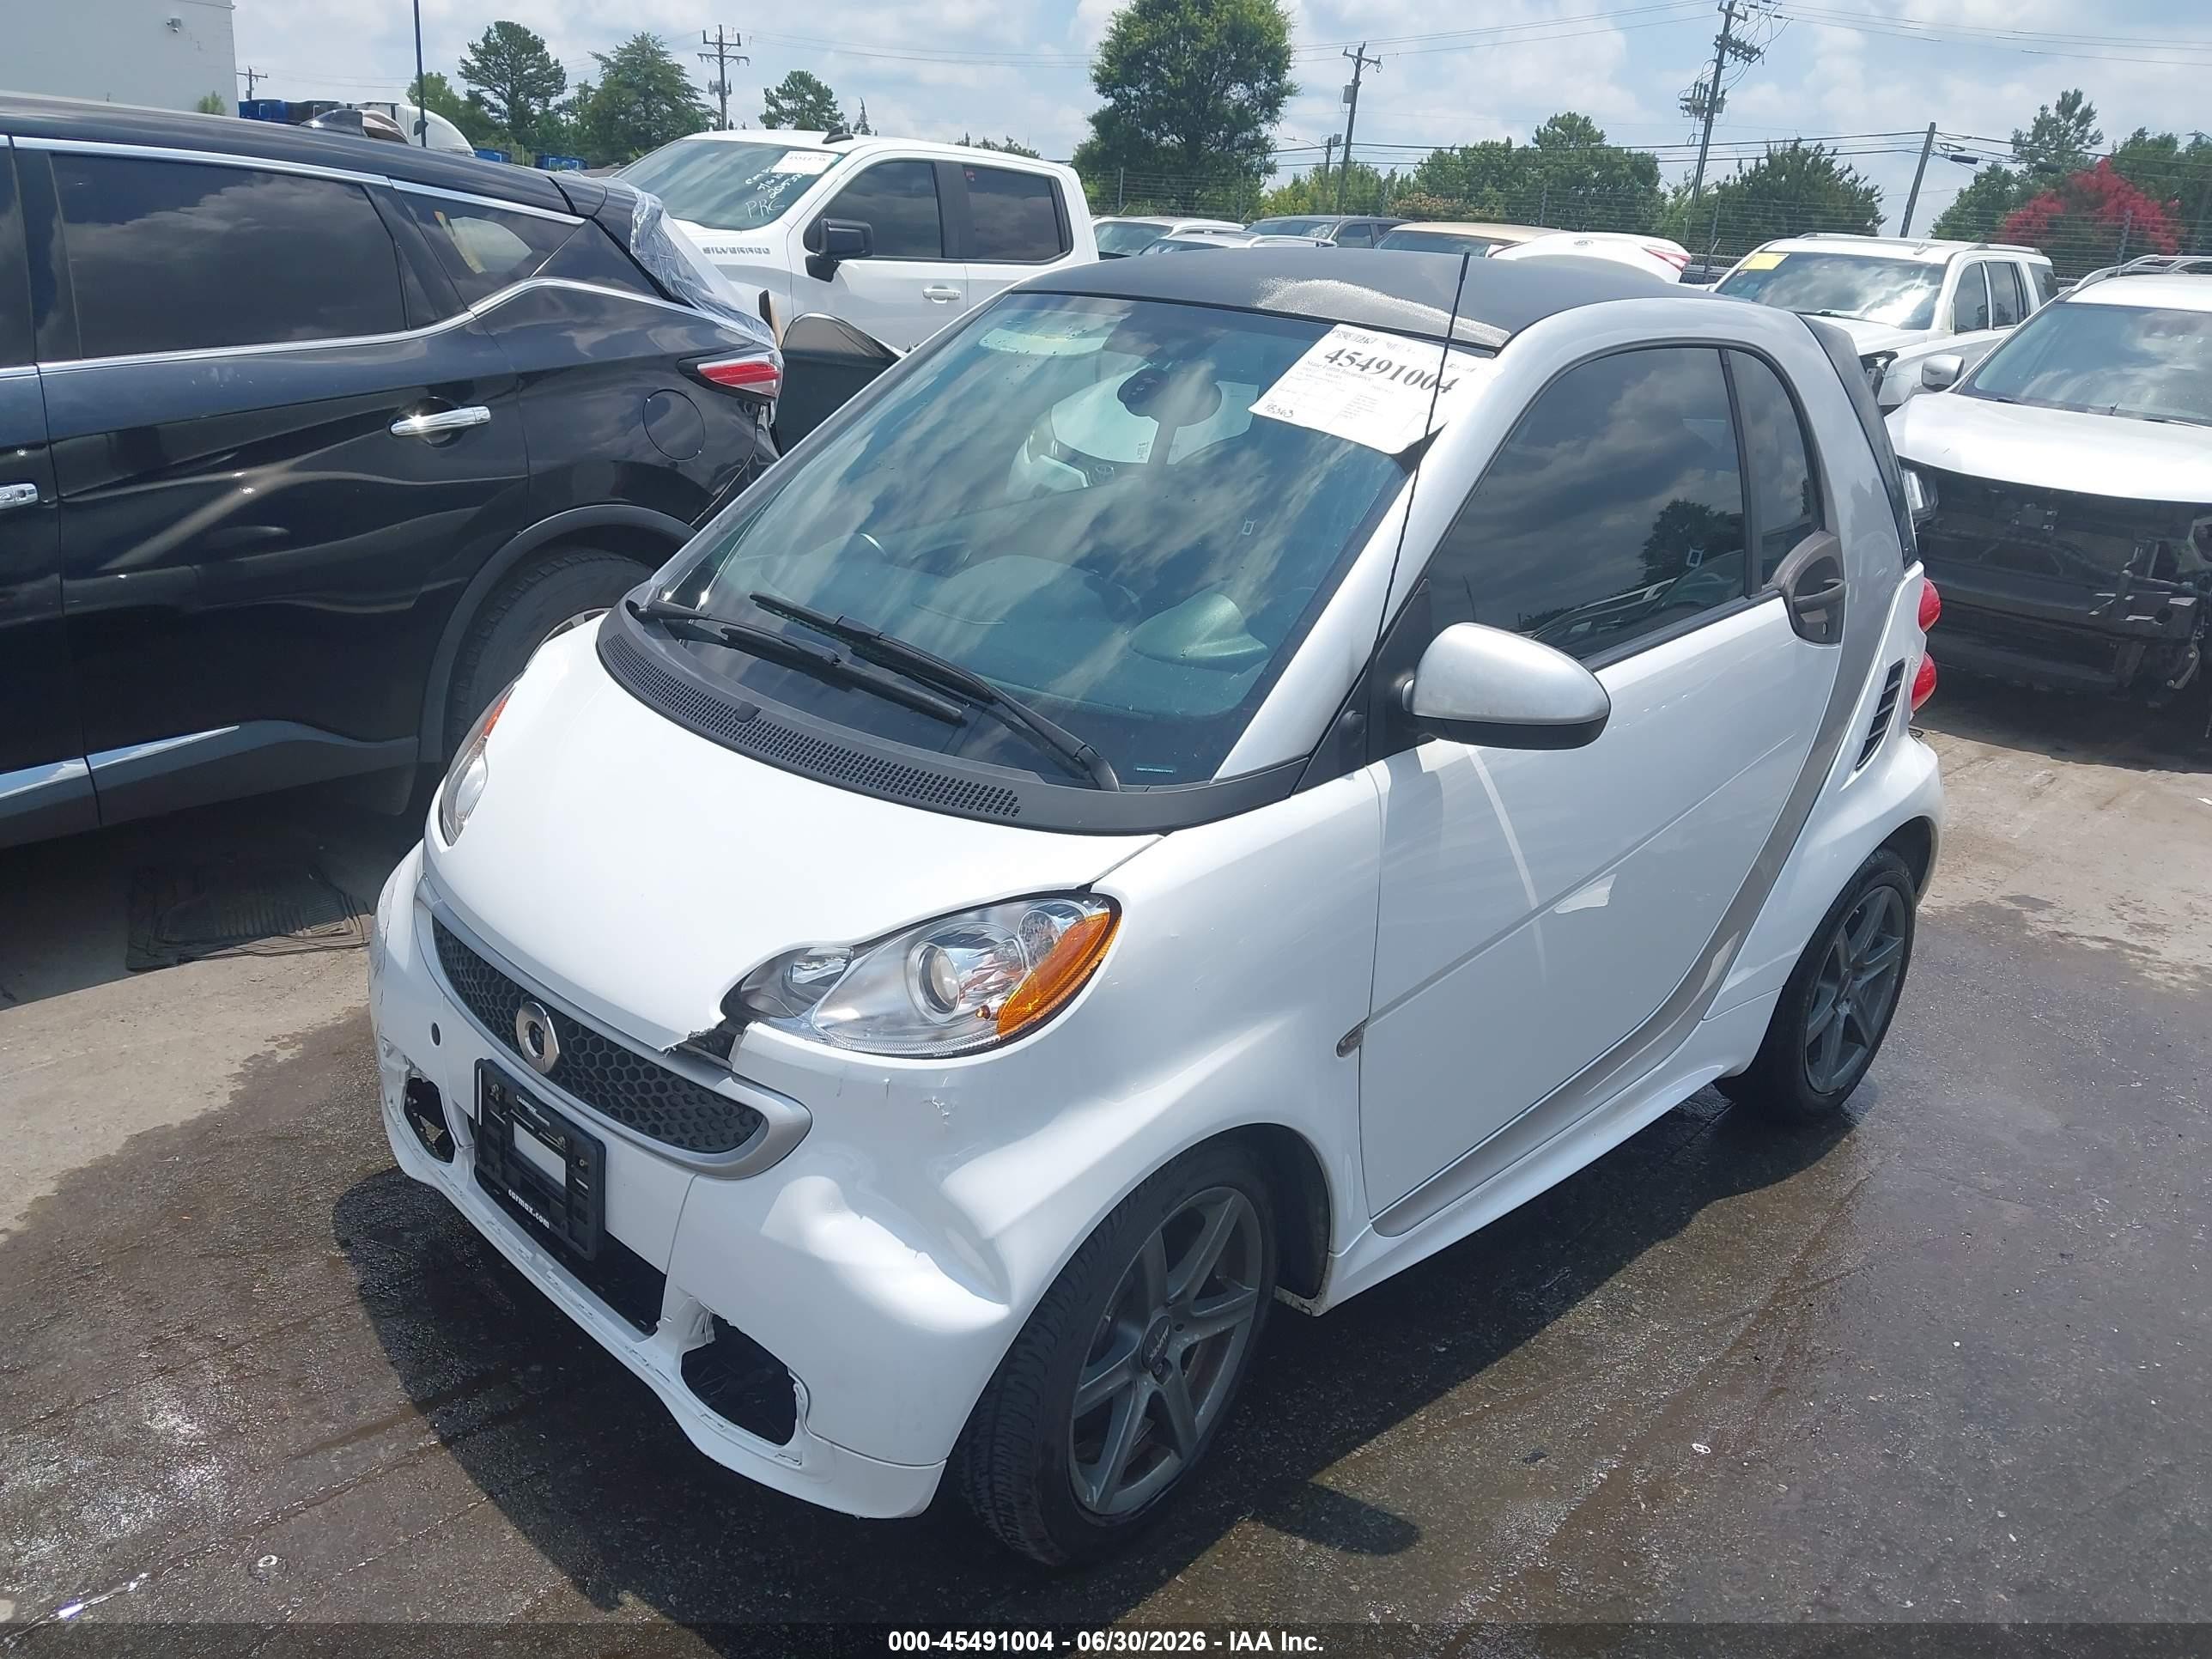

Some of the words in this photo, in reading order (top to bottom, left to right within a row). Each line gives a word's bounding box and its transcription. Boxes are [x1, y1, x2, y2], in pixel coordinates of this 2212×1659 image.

[702, 246, 771, 255] SILVERADO
[1324, 348, 1461, 393] 45491004
[507, 1188, 550, 1230] carmax.com
